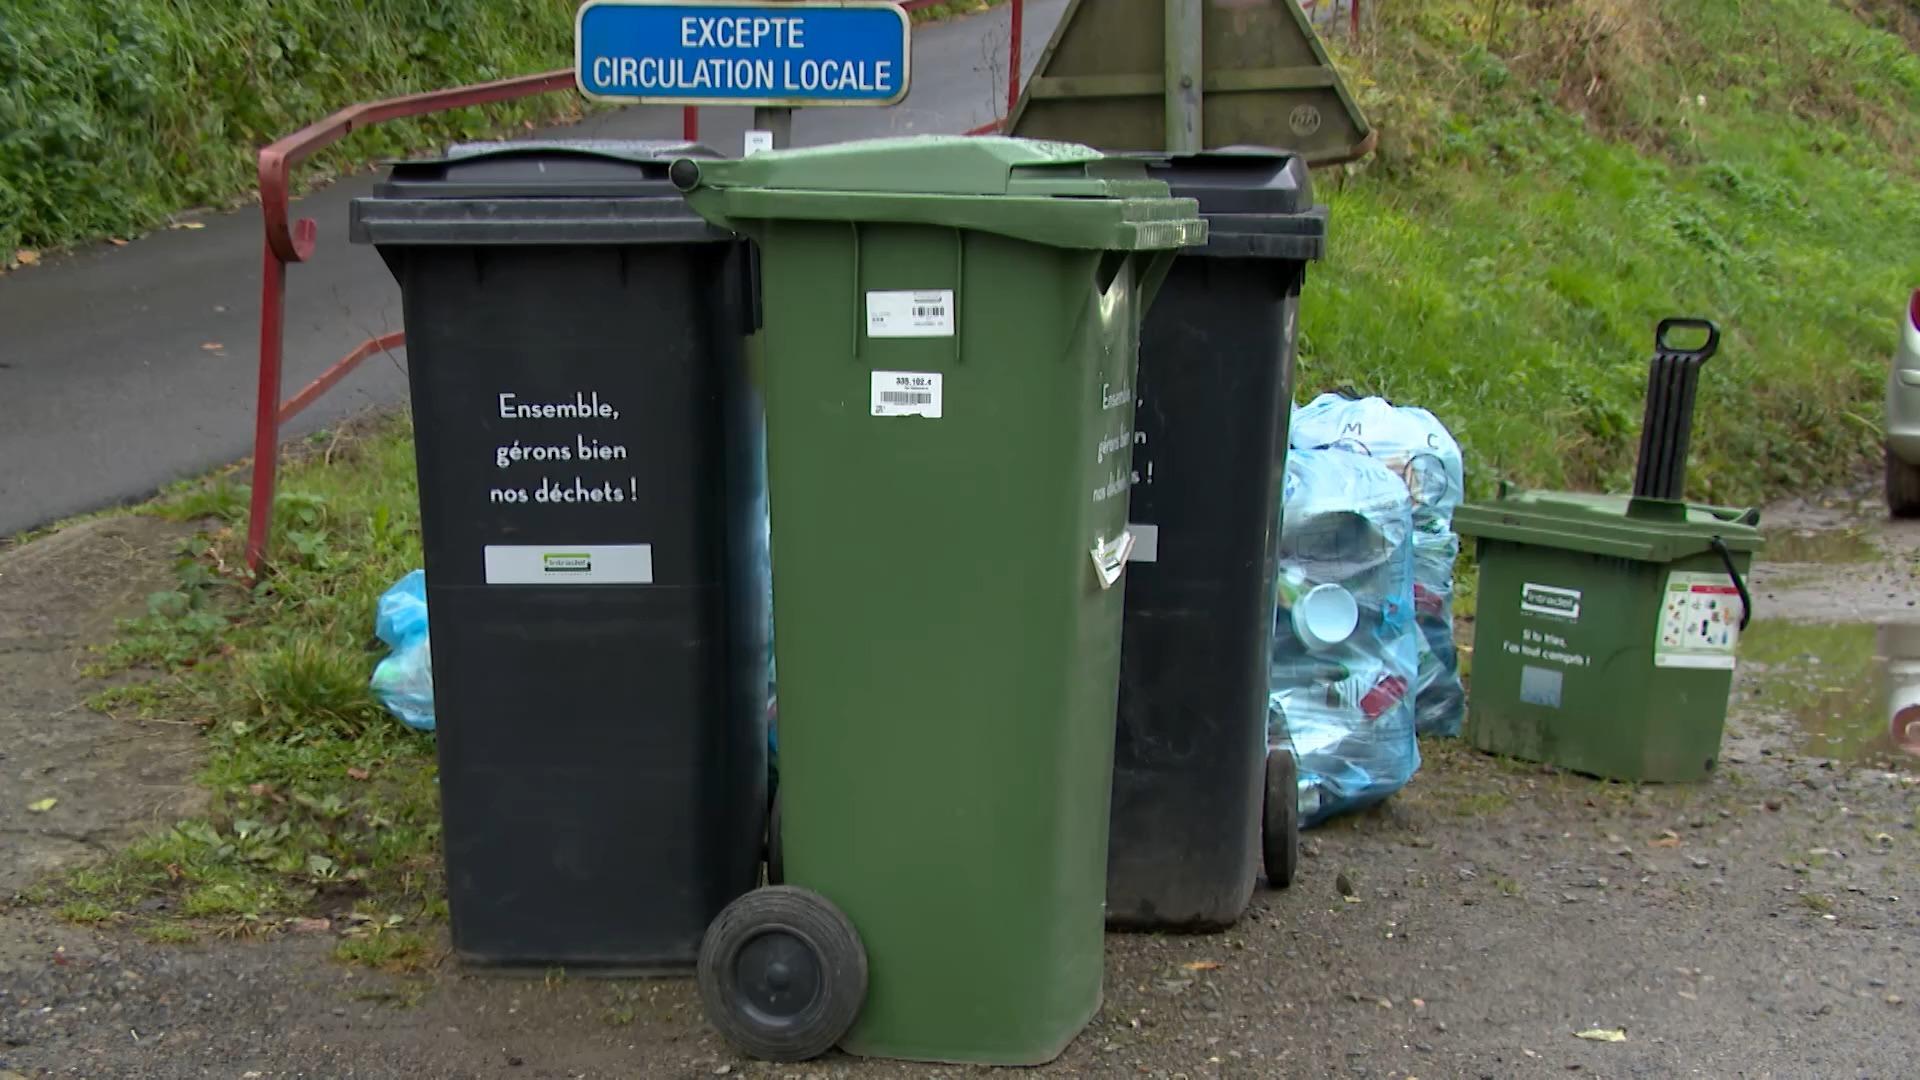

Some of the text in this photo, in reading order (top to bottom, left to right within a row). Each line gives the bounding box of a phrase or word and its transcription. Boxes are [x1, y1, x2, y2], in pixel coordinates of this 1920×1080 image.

[681, 17, 804, 49] EXCEPTE
[593, 56, 892, 91] CIRCULATION LOCALE
[498, 391, 620, 420] Ensemble,
[496, 433, 627, 468] gérons bien
[489, 476, 638, 503] nos déchets !
